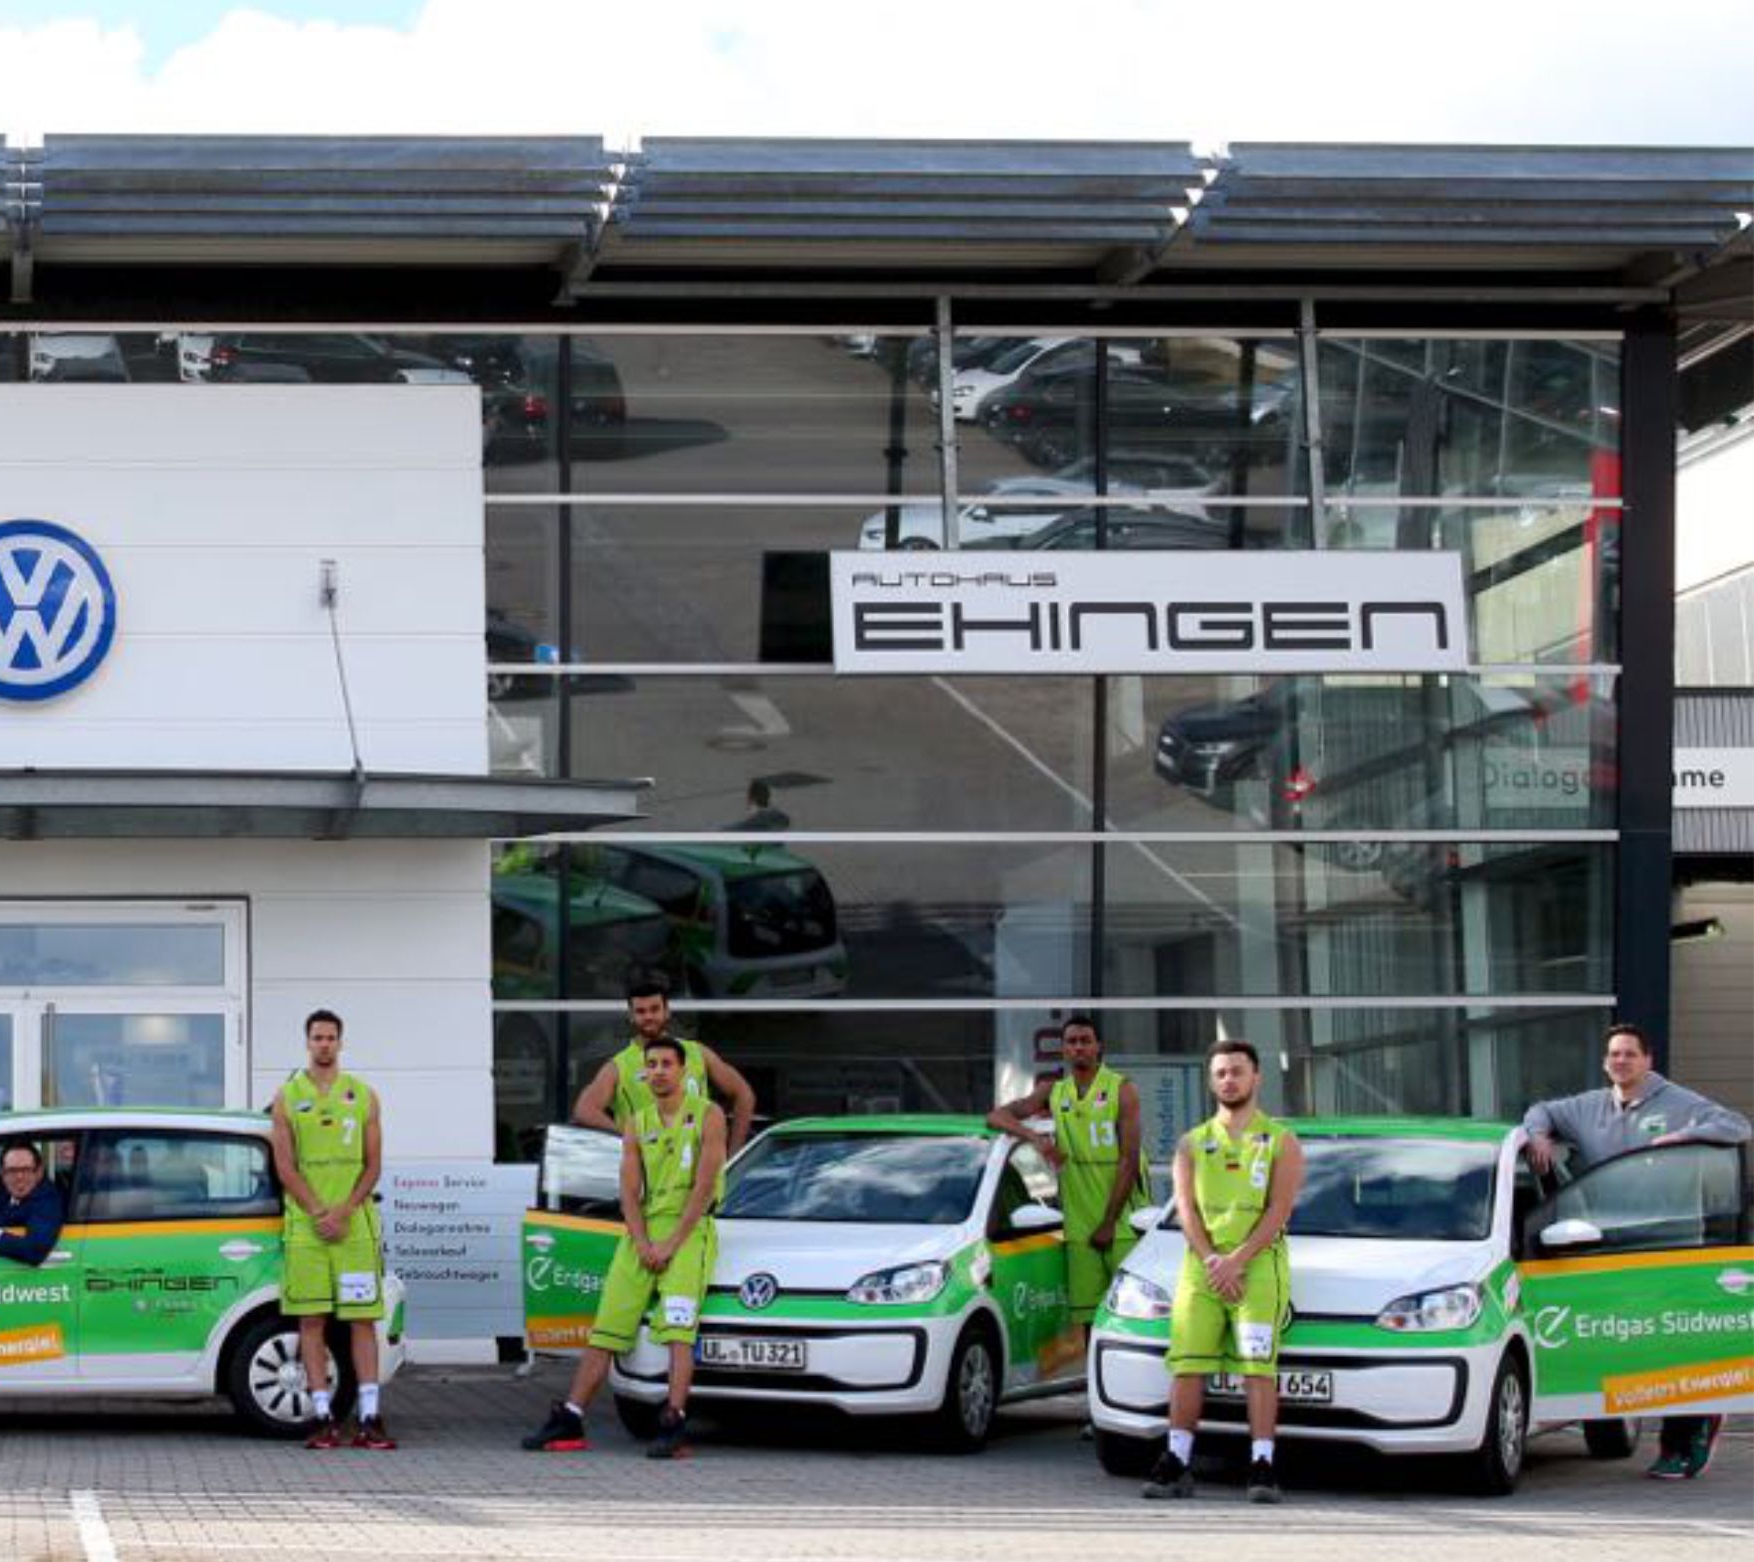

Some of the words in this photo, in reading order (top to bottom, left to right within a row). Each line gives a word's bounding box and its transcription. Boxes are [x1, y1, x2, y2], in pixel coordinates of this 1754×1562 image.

[851, 573, 1057, 587] AUTOHAUS
[854, 601, 1448, 651] EHINGEN
[1088, 1120, 1115, 1148] 13
[443, 1175, 488, 1188] Service
[394, 1200, 460, 1213] Neuwagen
[394, 1267, 500, 1282] Gebrauchtwagen
[1574, 1314, 1655, 1342] Erdgas
[703, 1341, 727, 1359] UL
[1286, 1373, 1328, 1394] 654
